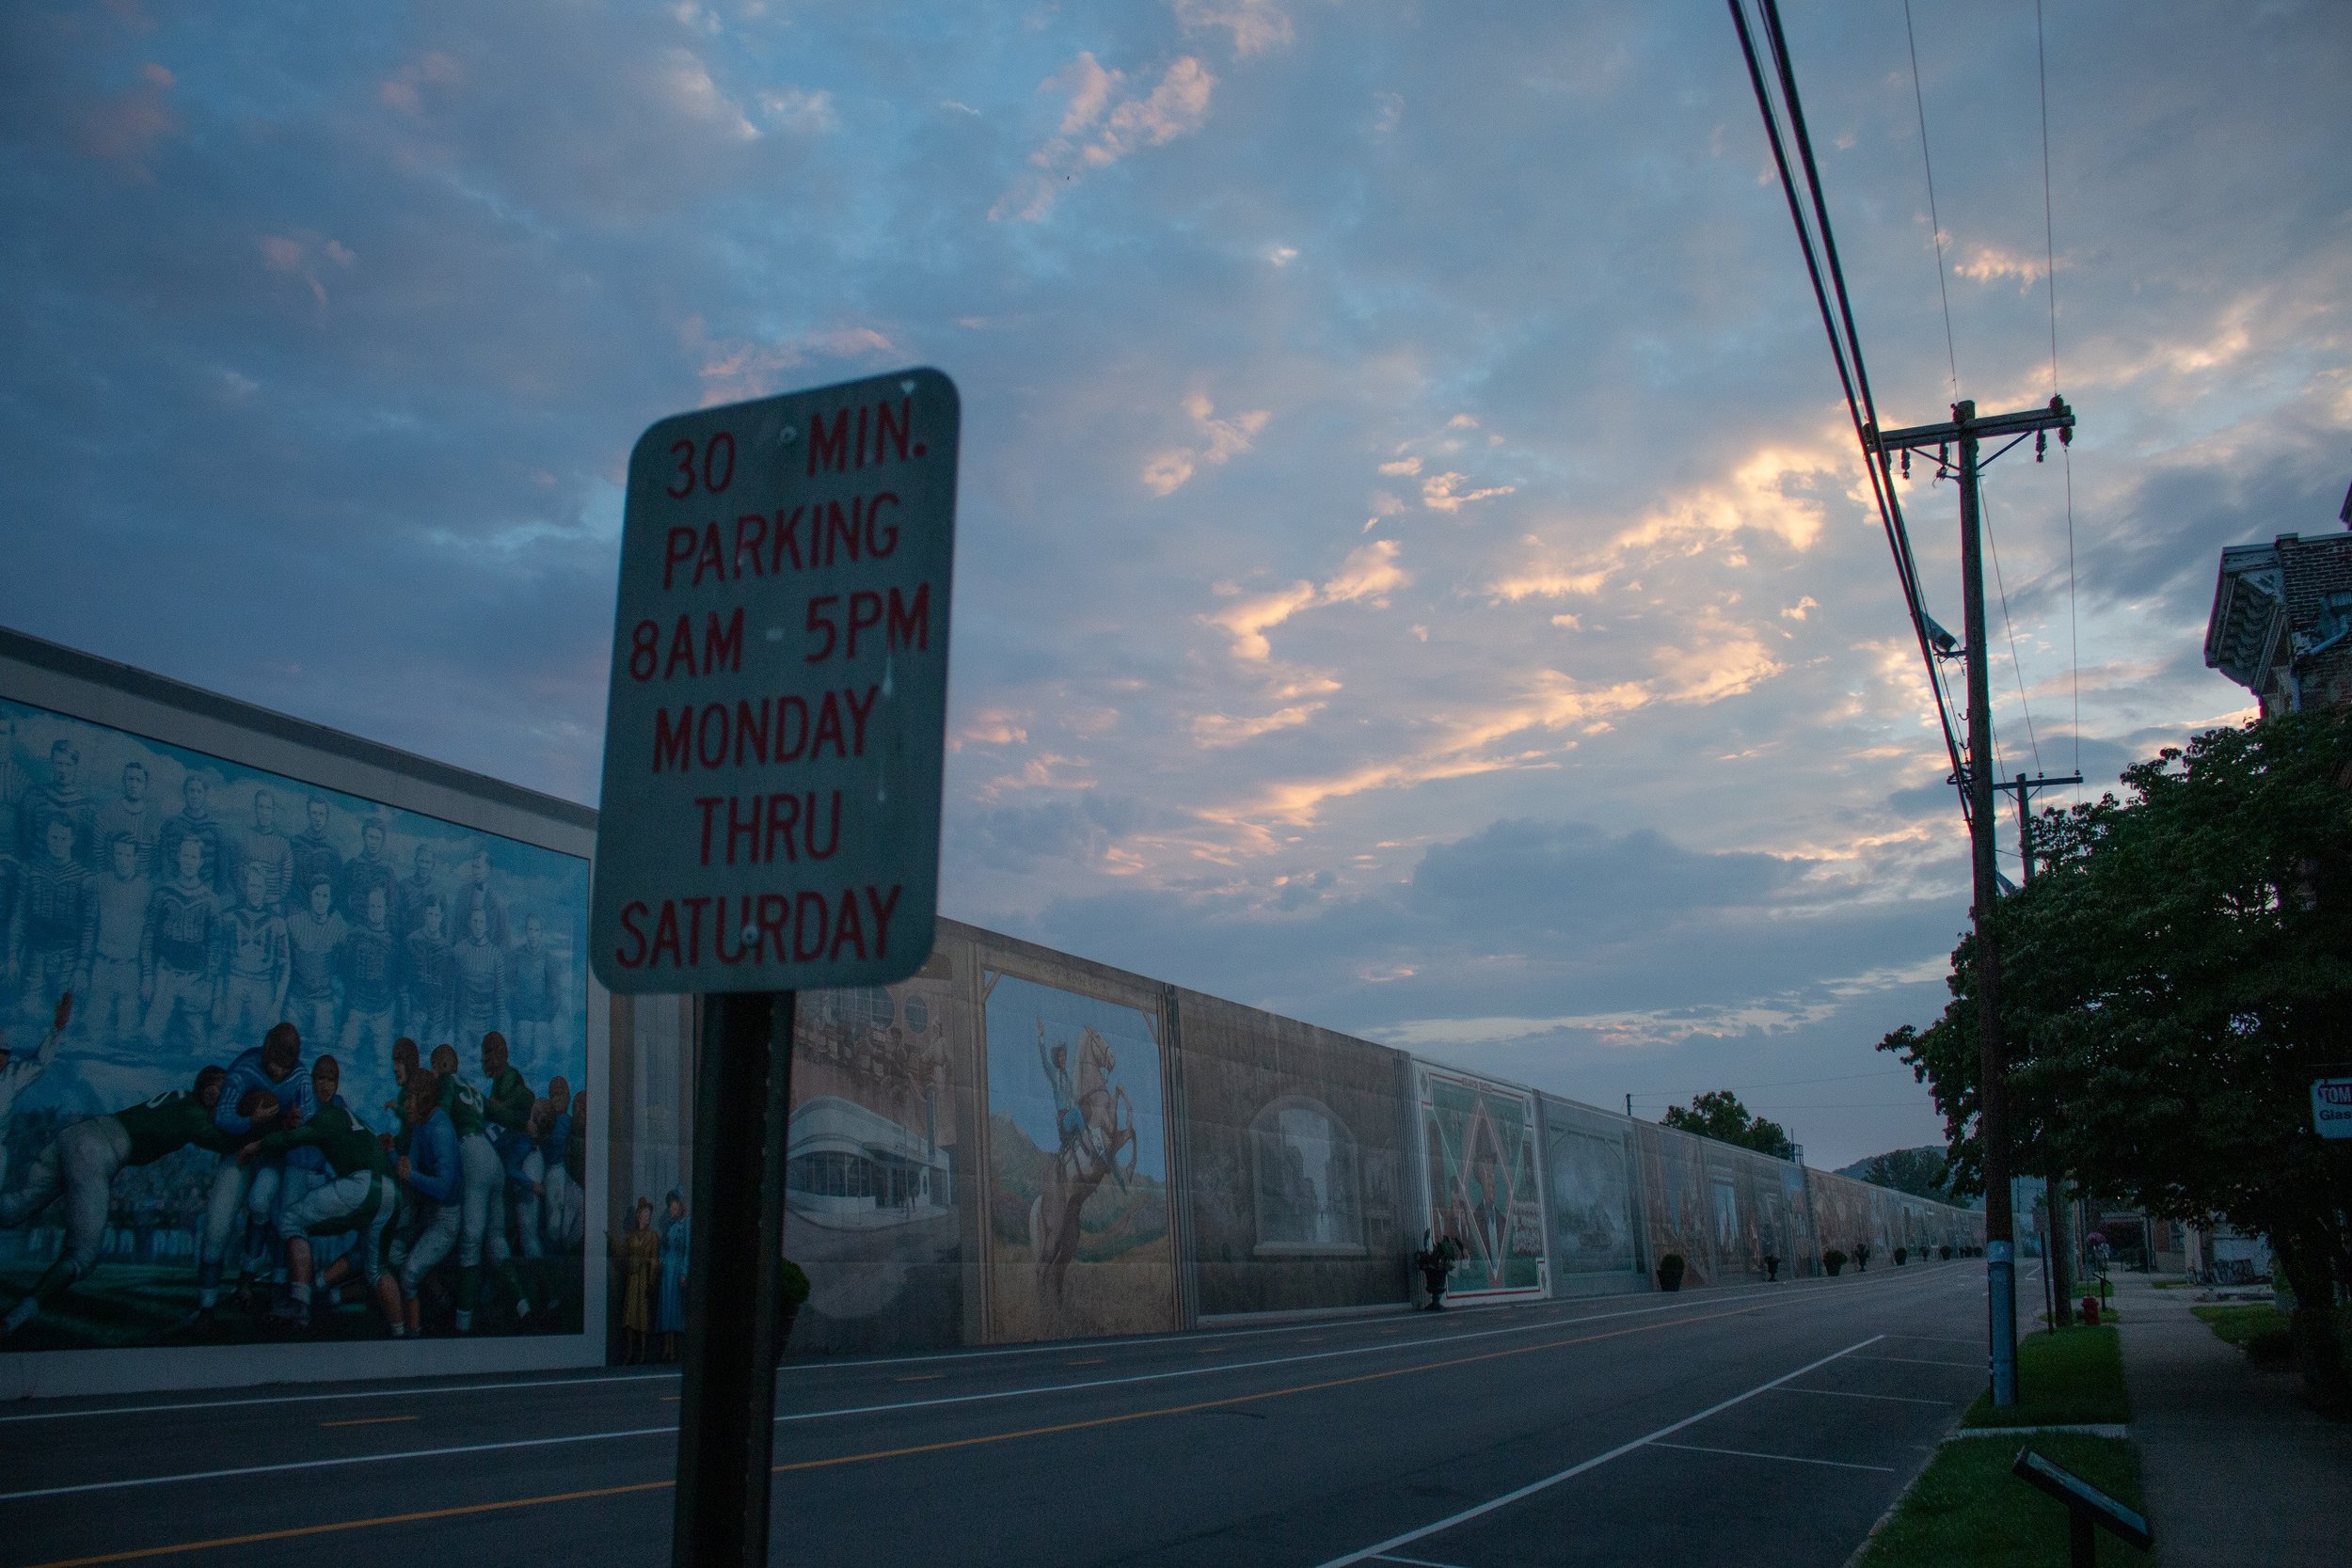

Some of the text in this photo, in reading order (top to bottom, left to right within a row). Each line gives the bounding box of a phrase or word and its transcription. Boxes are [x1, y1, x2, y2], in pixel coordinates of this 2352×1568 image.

[667, 396, 927, 499] 30 MIN.
[663, 491, 899, 590] PARKING
[630, 581, 930, 682] 8AM 5PM
[652, 685, 878, 773] MONDAY
[694, 789, 841, 866] THRU
[616, 883, 903, 969] SATURDAY
